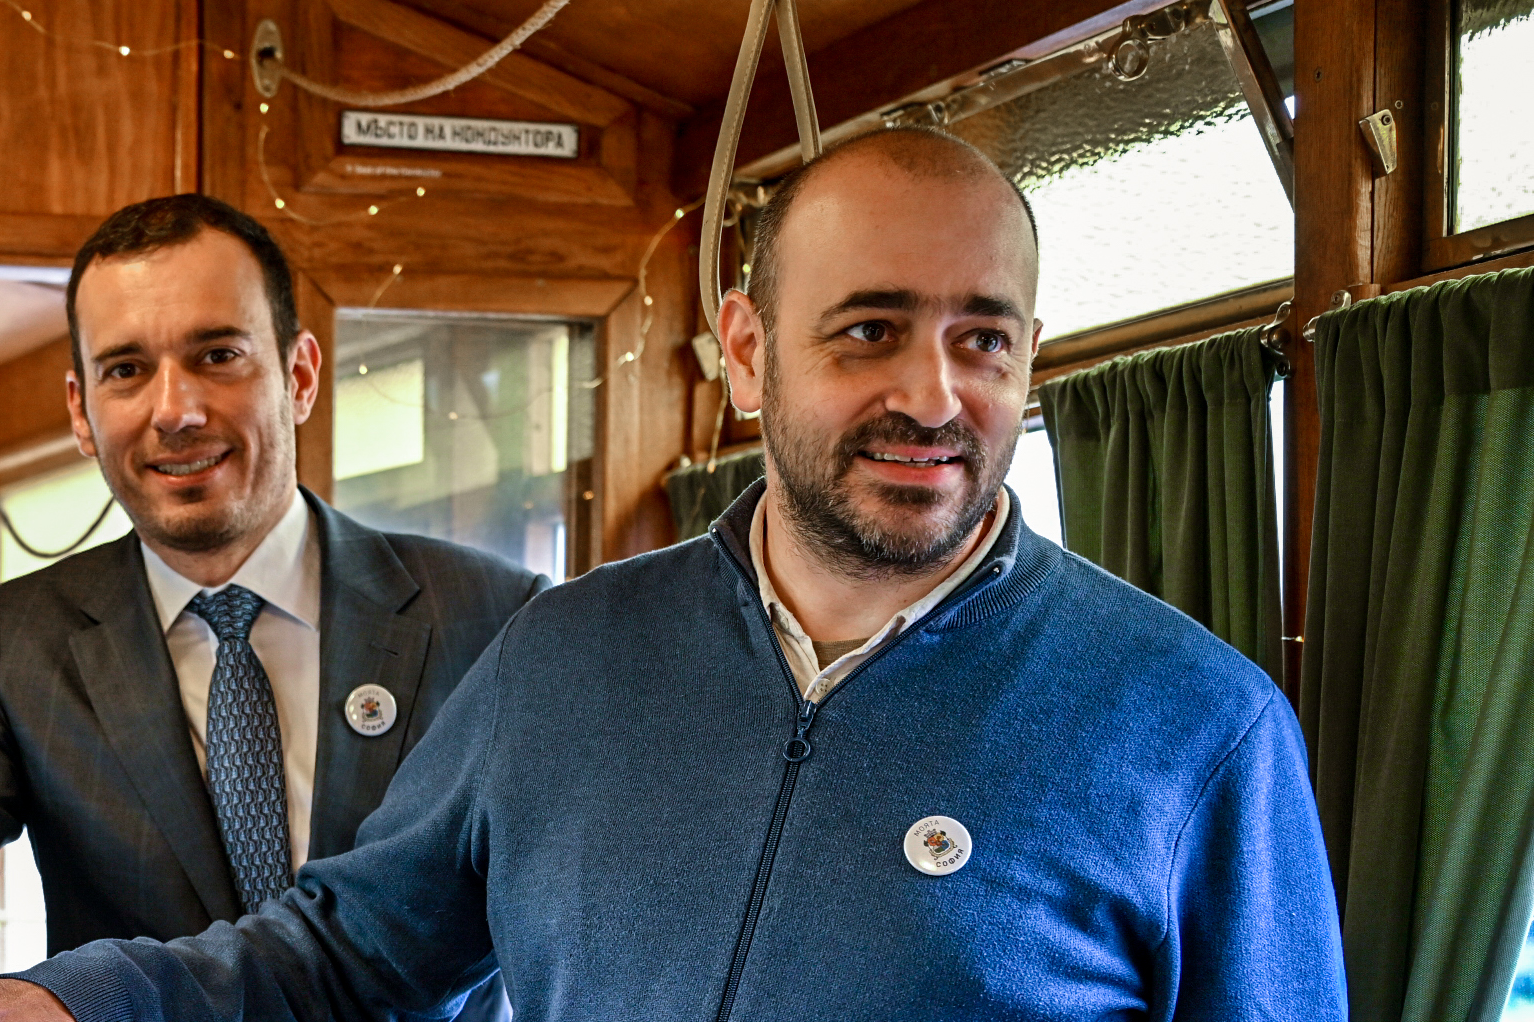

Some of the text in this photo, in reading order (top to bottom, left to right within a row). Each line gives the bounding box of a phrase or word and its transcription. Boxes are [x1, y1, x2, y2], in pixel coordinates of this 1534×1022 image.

[424, 124, 448, 143] НА
[361, 721, 385, 731] СОФИЯ
[914, 820, 939, 836] МОЯТА
[936, 849, 964, 867] СОФИЯ
